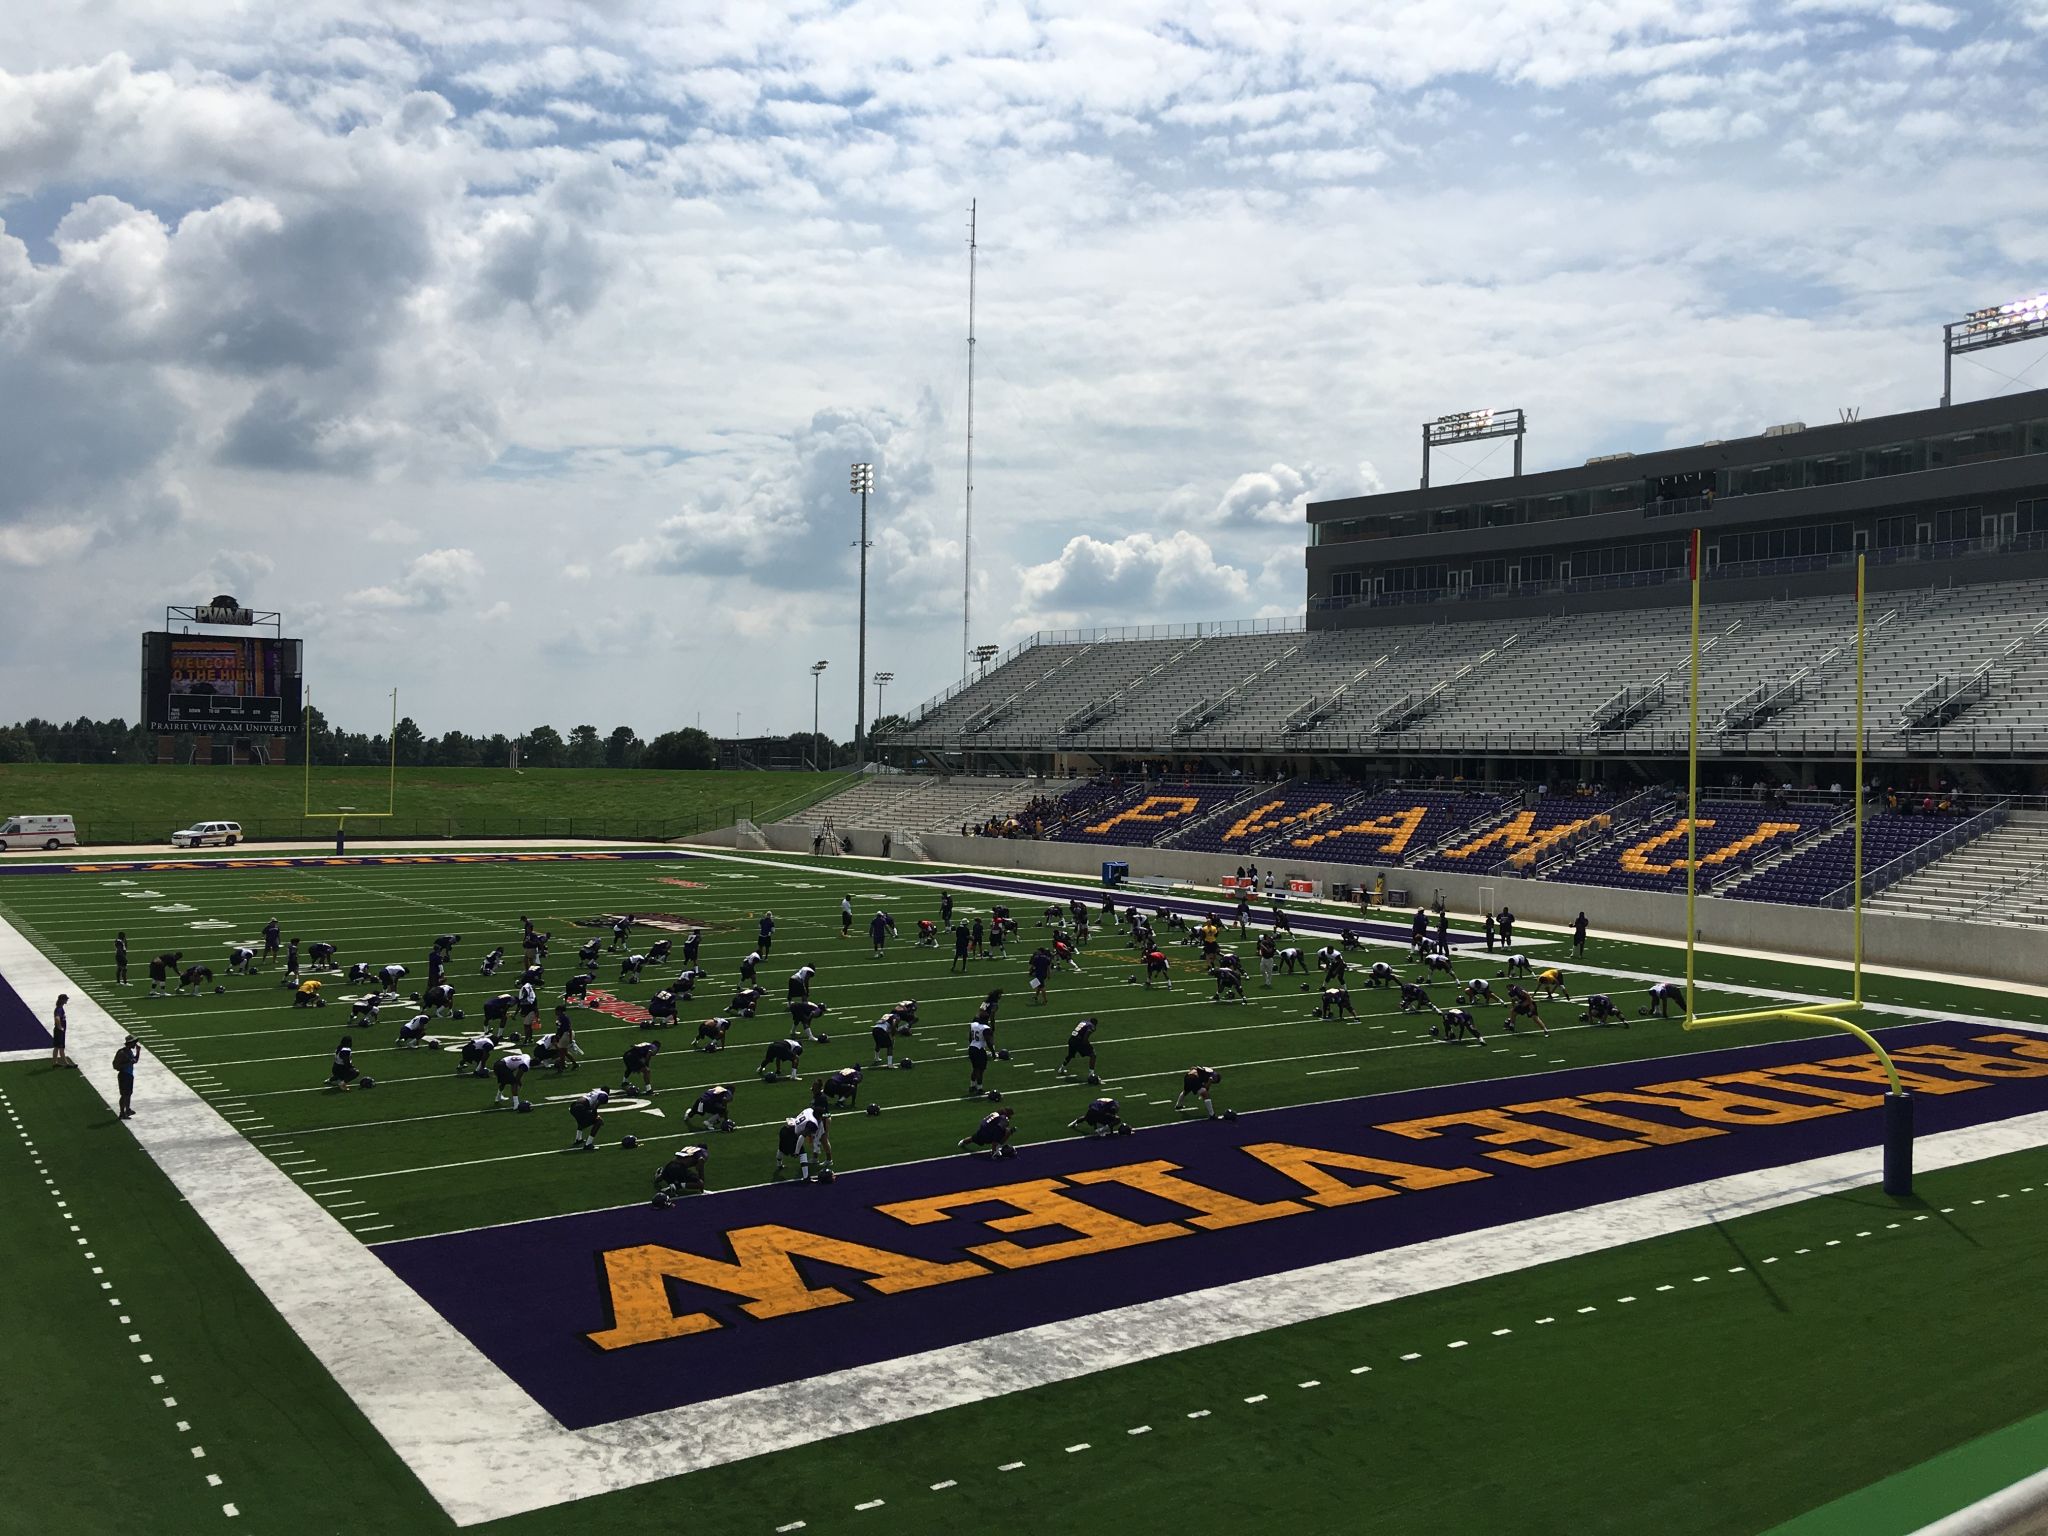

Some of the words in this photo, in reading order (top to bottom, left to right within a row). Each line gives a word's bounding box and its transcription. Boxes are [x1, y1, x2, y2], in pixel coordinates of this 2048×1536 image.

[197, 606, 251, 624] PVAMU
[172, 657, 246, 669] WELCOME
[186, 670, 216, 681] THE
[150, 721, 189, 730] PRAIRIE
[191, 722, 217, 731] VIEW
[219, 722, 243, 732] A&M
[245, 723, 298, 733] UNIVERSITY
[1083, 796, 1801, 875] PVAMU
[586, 1141, 1494, 1351] VIEW
